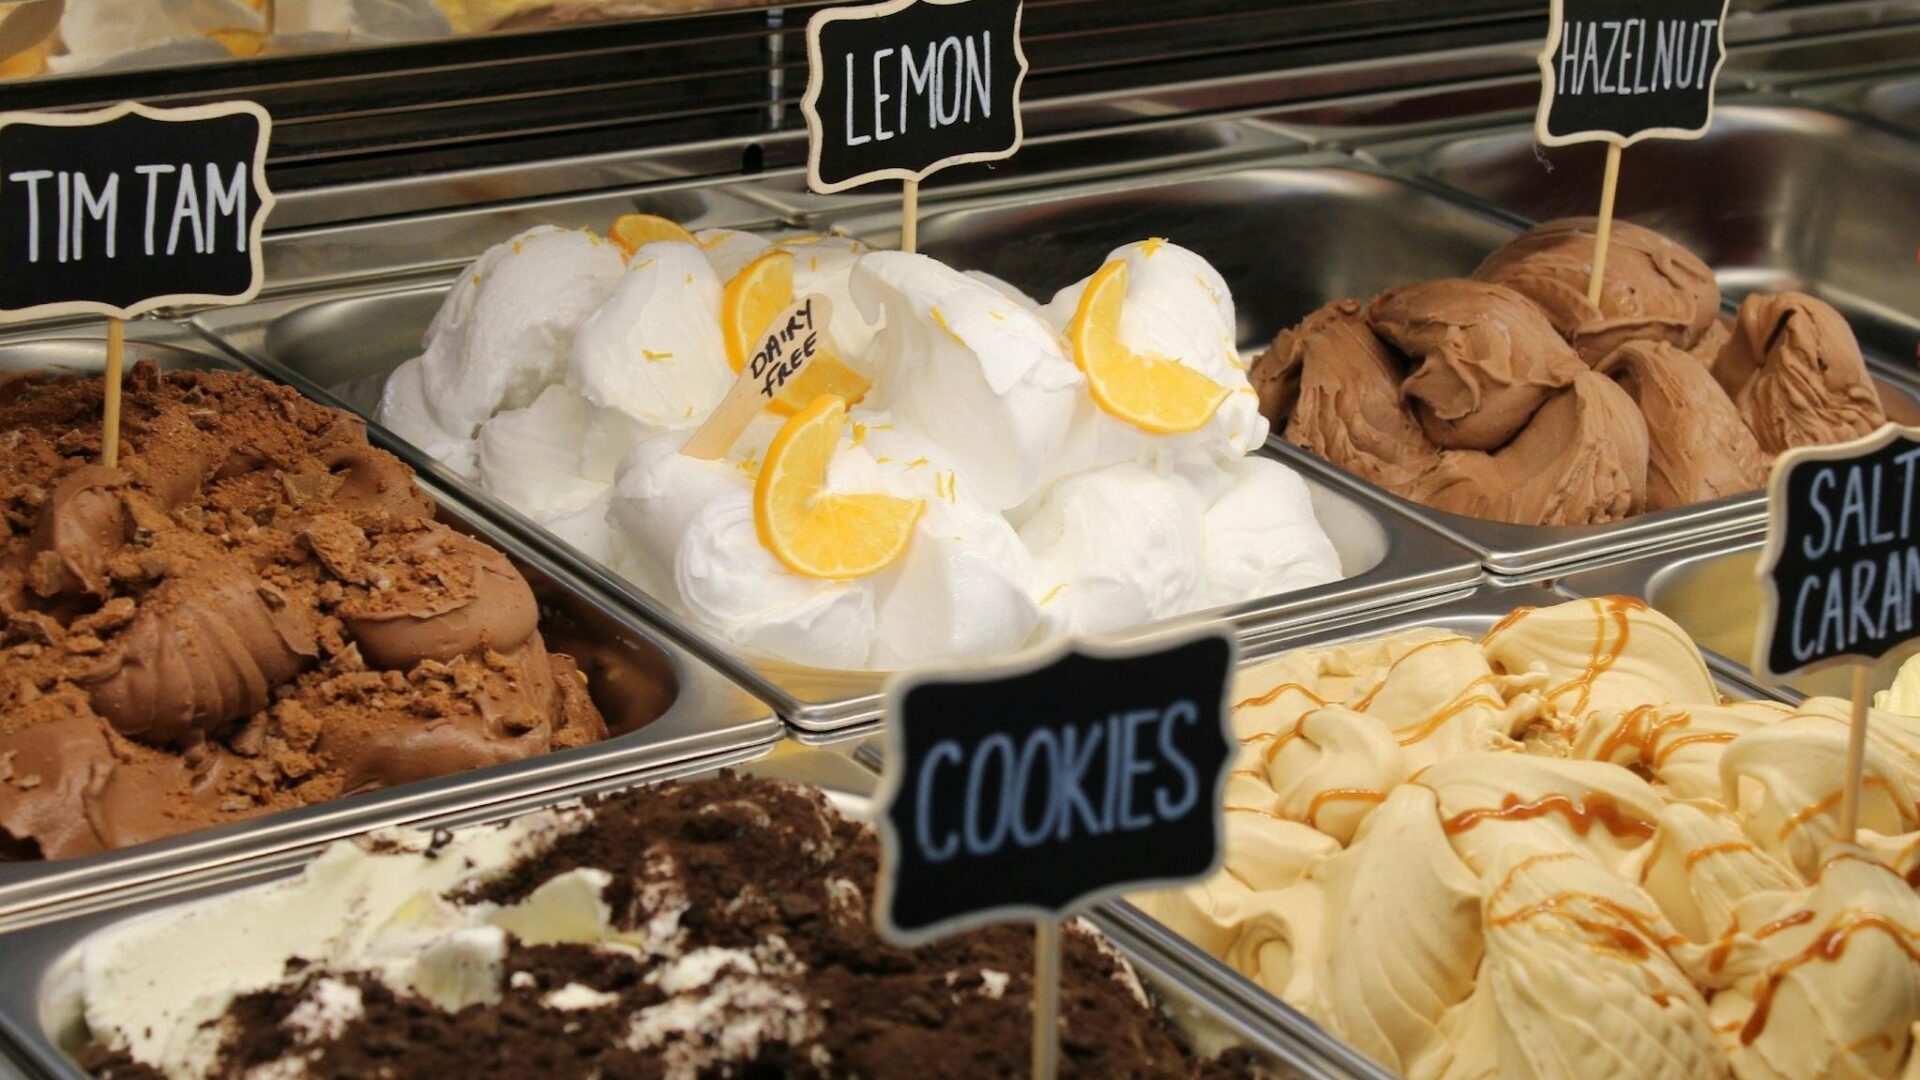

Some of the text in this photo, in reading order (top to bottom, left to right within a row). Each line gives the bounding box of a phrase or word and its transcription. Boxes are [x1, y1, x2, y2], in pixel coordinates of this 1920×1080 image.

[846, 30, 991, 146] LEMON
[1558, 18, 1718, 95] HAZELNUT
[9, 161, 247, 263] TIM TAM
[750, 298, 813, 379] DAIRY
[761, 331, 817, 398] FREE
[916, 700, 1198, 862] COOKIES
